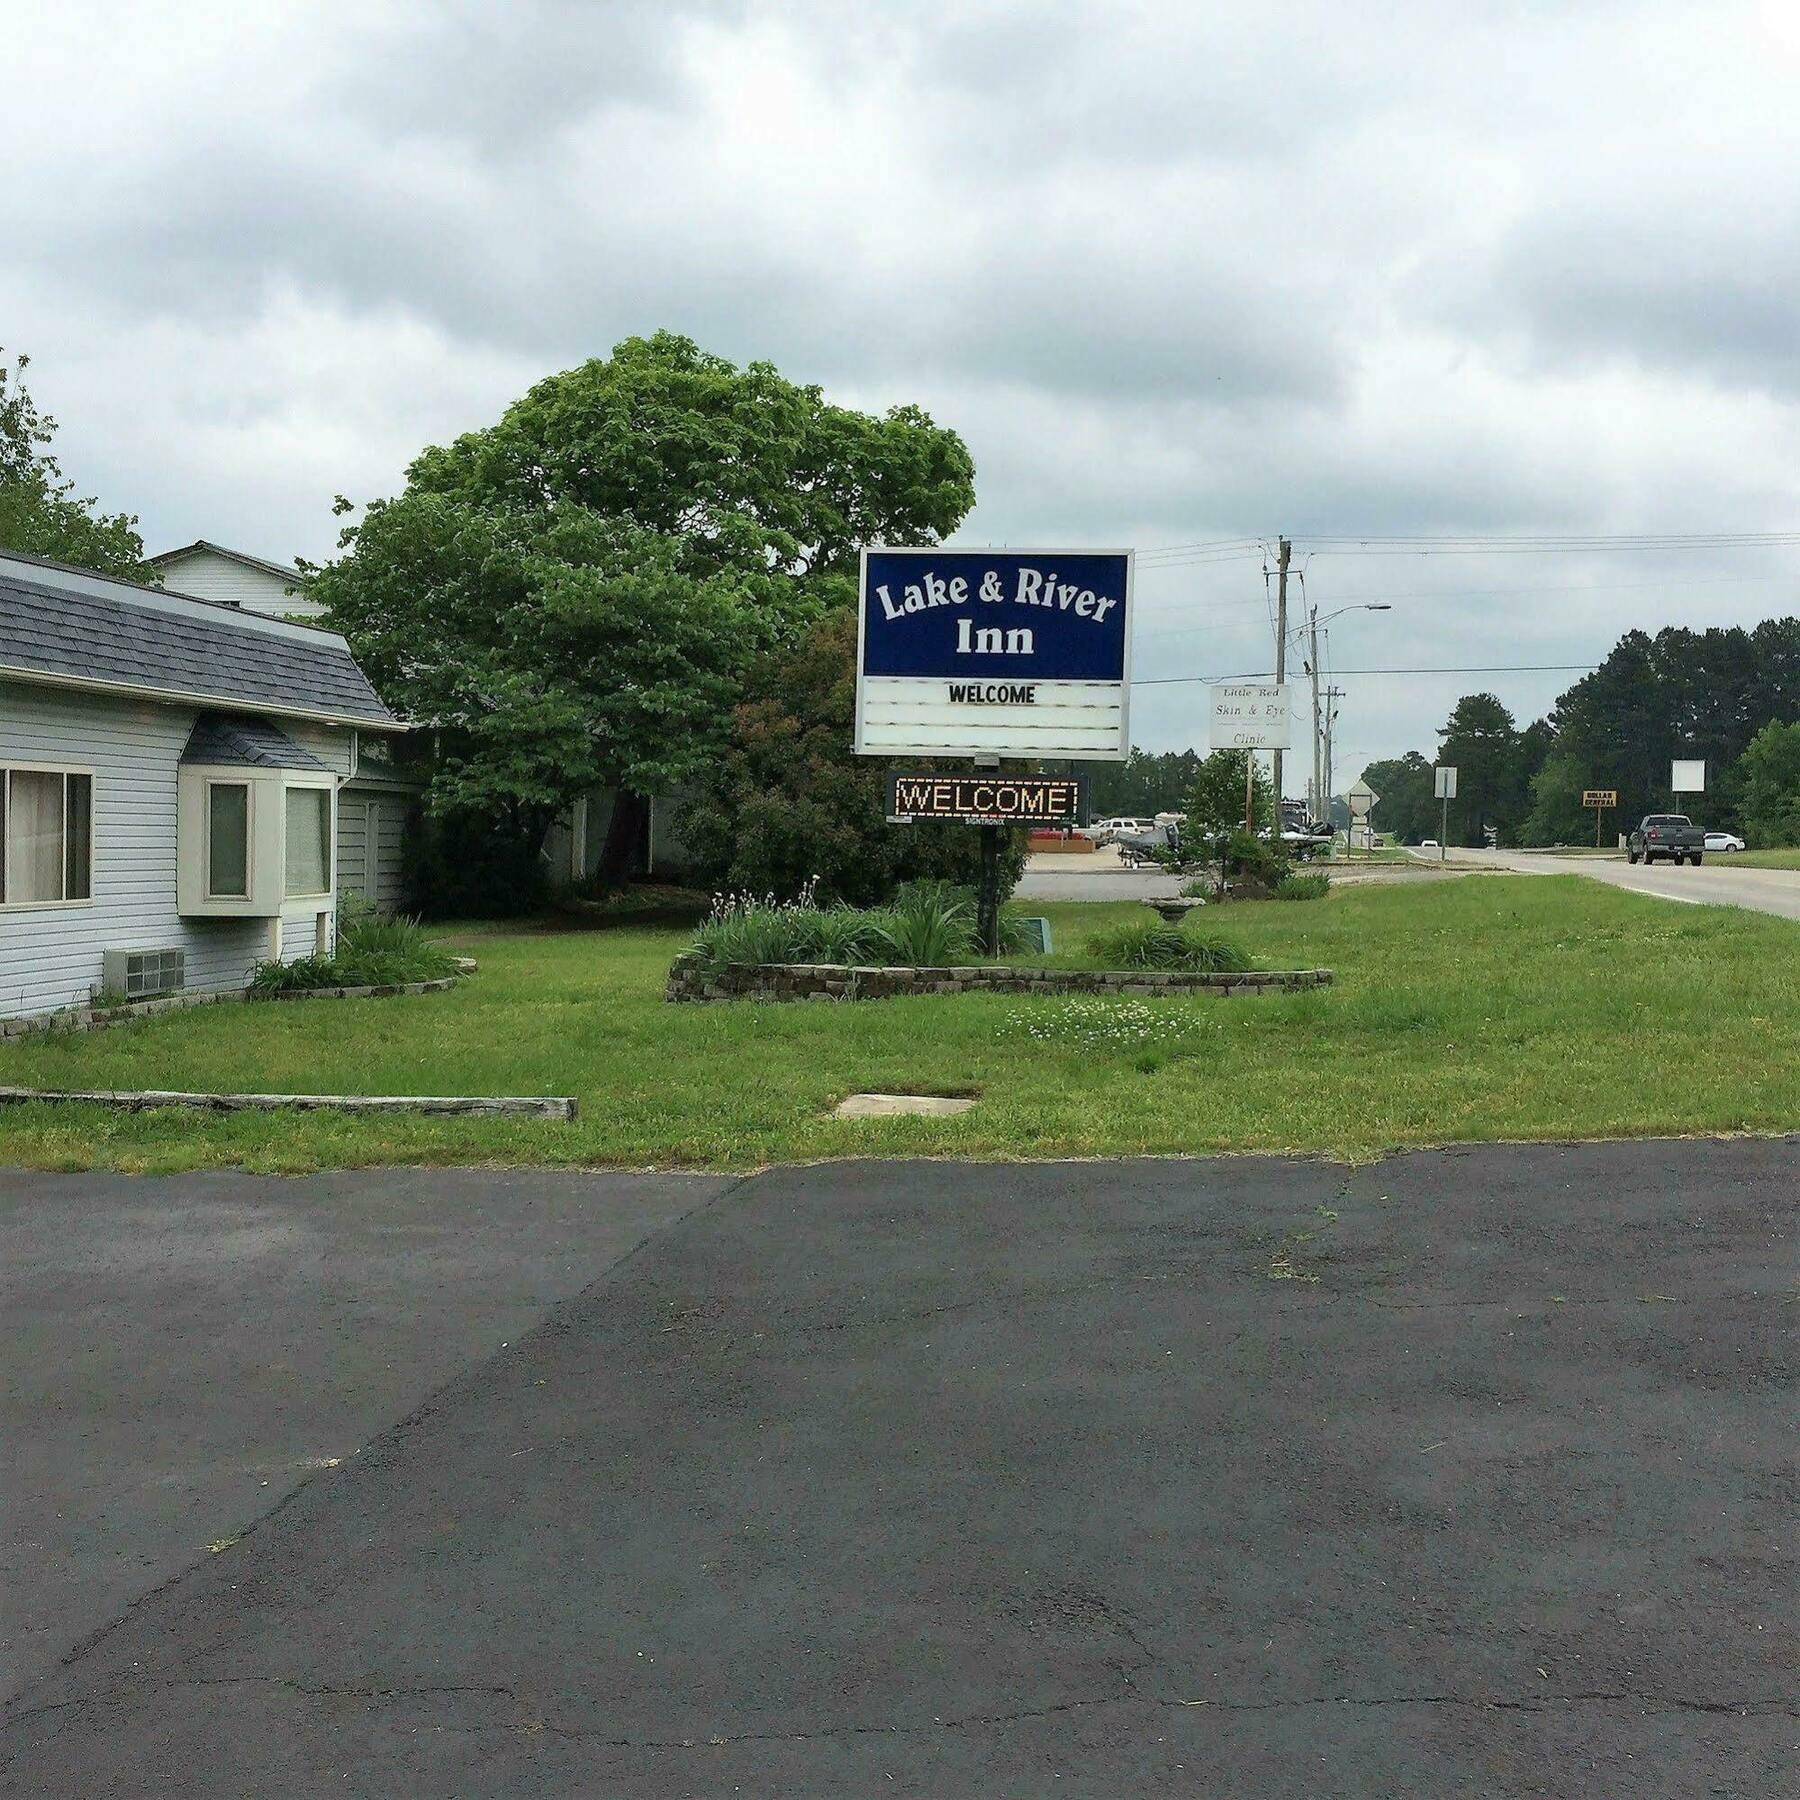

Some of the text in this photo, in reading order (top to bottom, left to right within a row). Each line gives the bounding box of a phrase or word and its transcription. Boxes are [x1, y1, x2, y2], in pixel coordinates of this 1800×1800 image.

[876, 567, 1117, 623] Lake & River
[956, 618, 1034, 654] Inn
[949, 685, 1035, 703] WELCOME
[1224, 688, 1279, 697] Little Red
[1216, 704, 1241, 715] Skin
[1248, 705, 1257, 715] &
[1233, 733, 1266, 744] Clinic
[900, 784, 1066, 814] WELCOME
